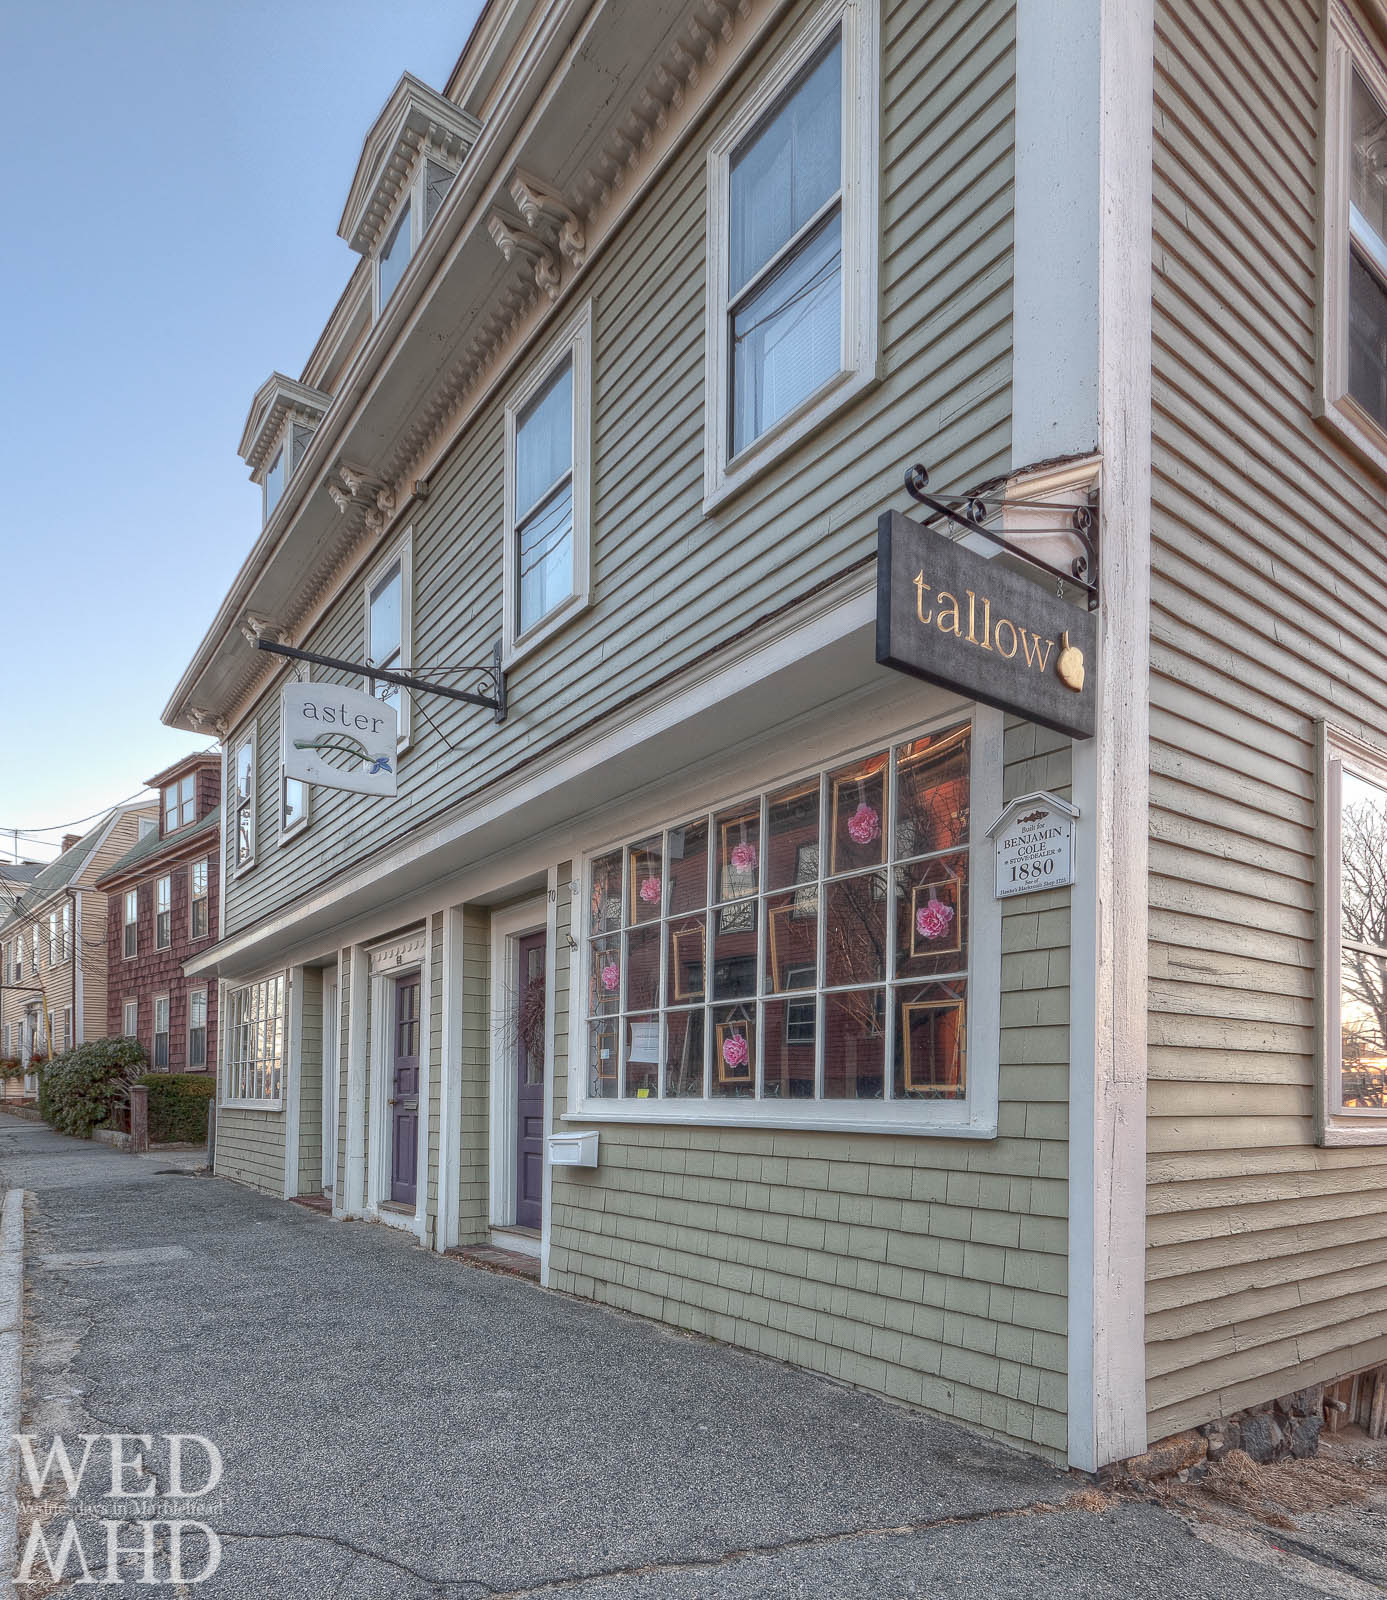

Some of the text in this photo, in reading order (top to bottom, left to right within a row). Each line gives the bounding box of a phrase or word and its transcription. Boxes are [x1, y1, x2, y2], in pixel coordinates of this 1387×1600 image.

[912, 569, 1055, 673] tallow
[303, 702, 384, 733] aster
[1004, 826, 1062, 849] BENJAMIN
[1022, 822, 1045, 833] Built for
[1017, 842, 1047, 856] COLE
[1009, 858, 1054, 882] 1880
[547, 889, 556, 903] 70
